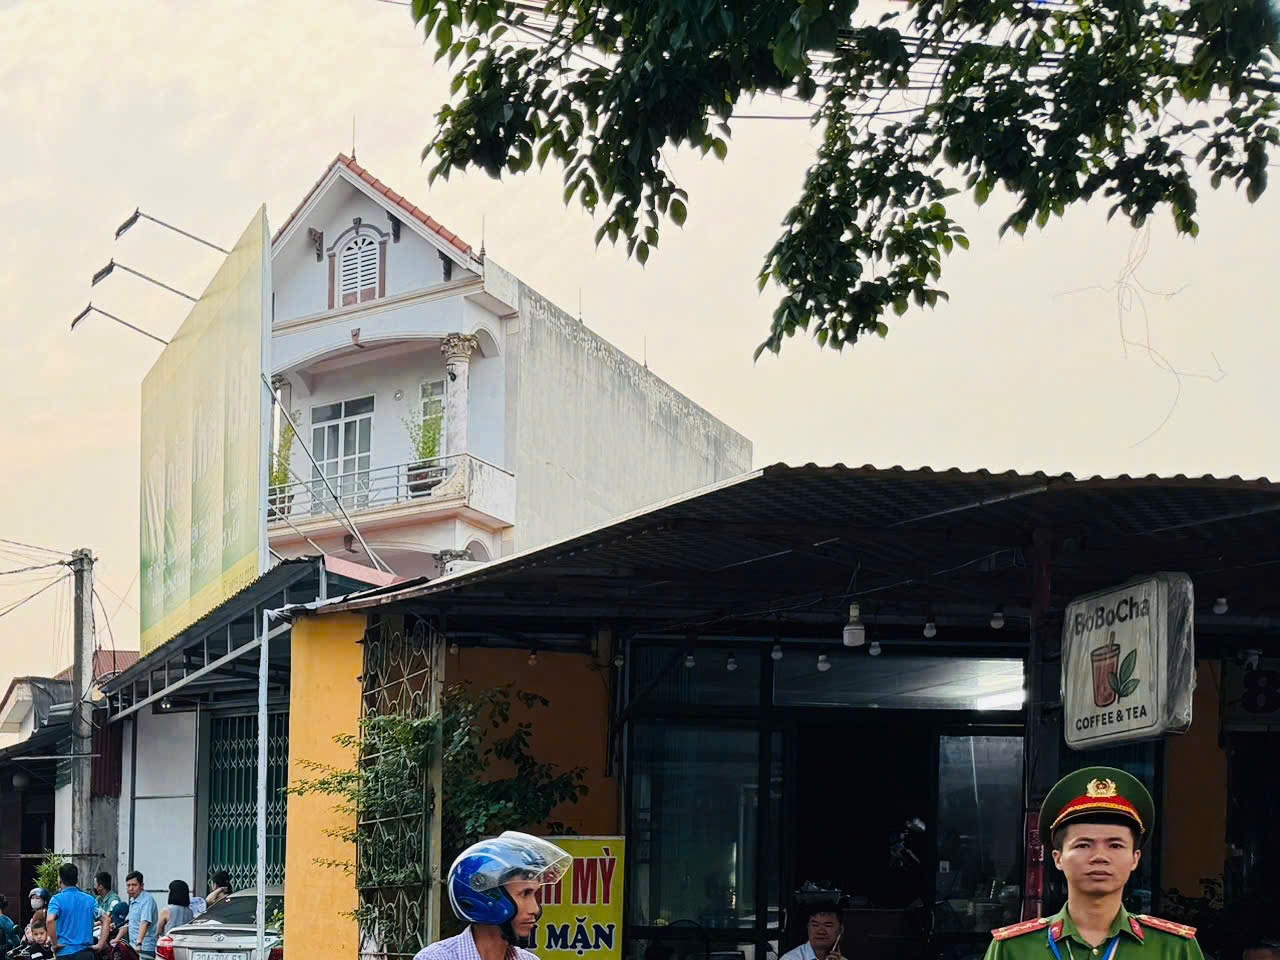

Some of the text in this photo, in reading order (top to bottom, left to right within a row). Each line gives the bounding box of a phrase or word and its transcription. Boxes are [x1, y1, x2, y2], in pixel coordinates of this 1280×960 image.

[1075, 704, 1148, 731] COFFEE & TEA
[572, 847, 617, 905] MỲ
[545, 916, 617, 956] MẶN
